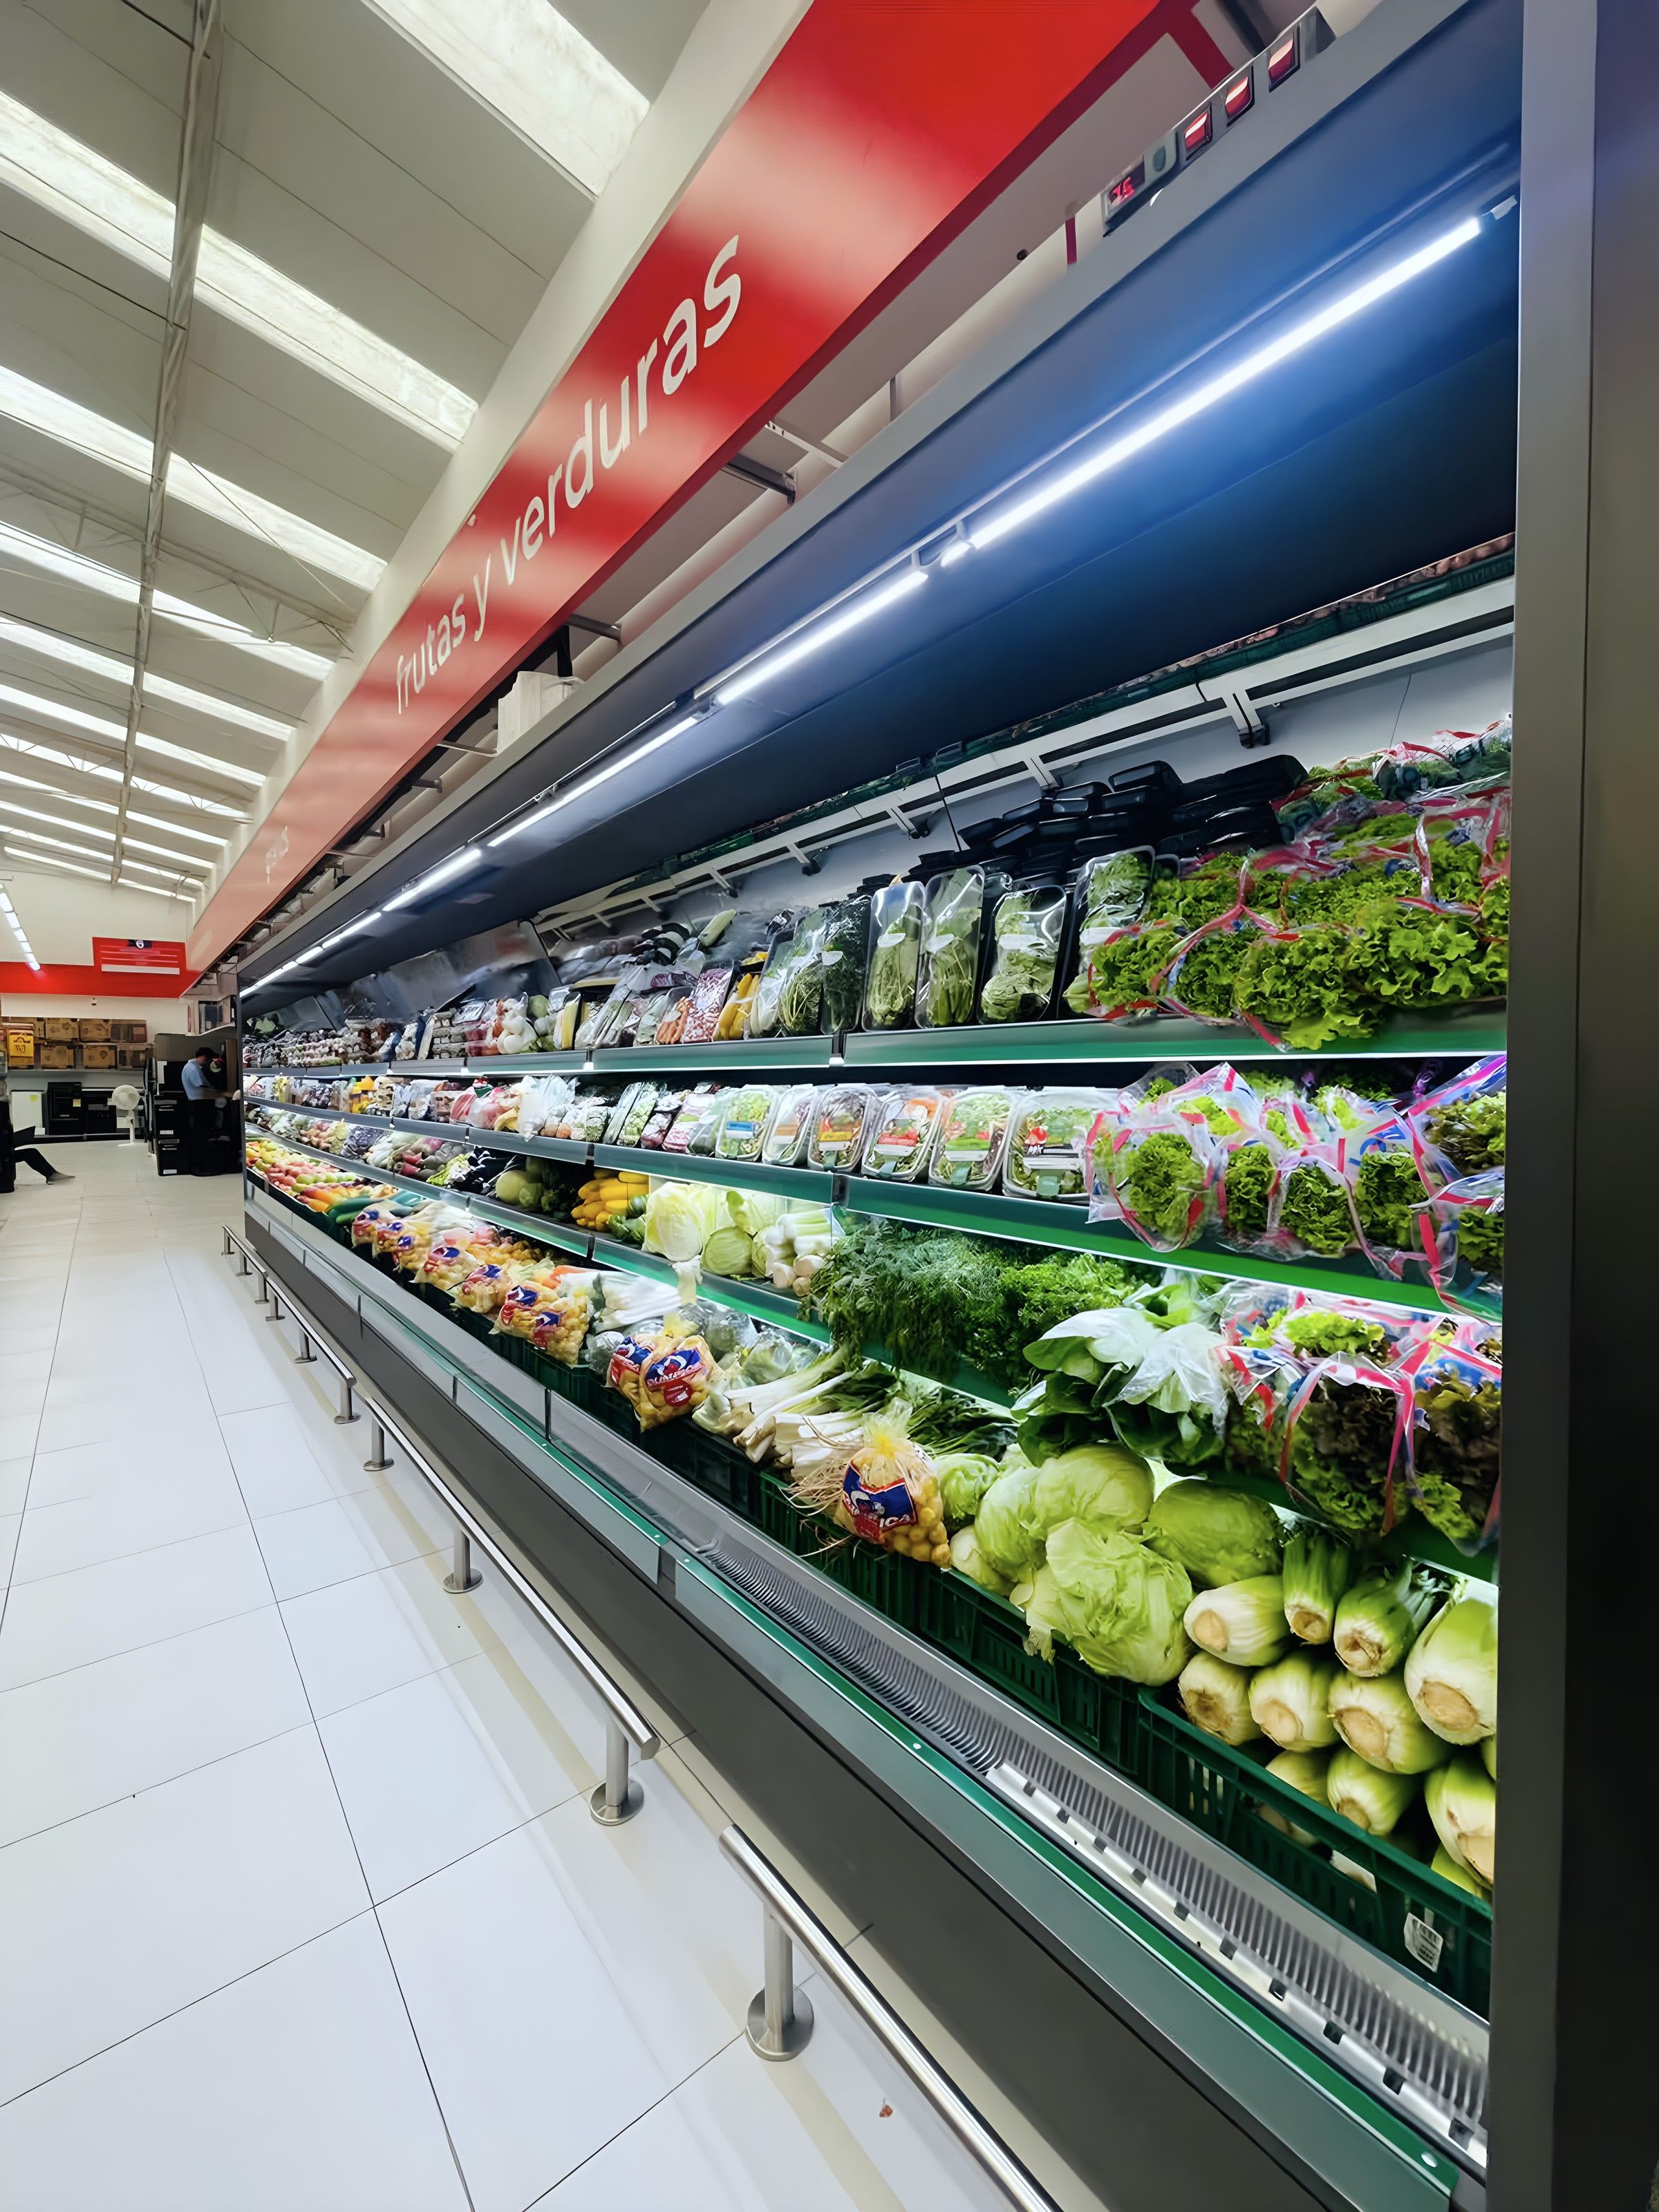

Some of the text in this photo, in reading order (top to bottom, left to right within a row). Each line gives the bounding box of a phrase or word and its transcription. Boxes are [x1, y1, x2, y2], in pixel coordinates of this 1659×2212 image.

[397, 235, 741, 715] frutas y verduras
